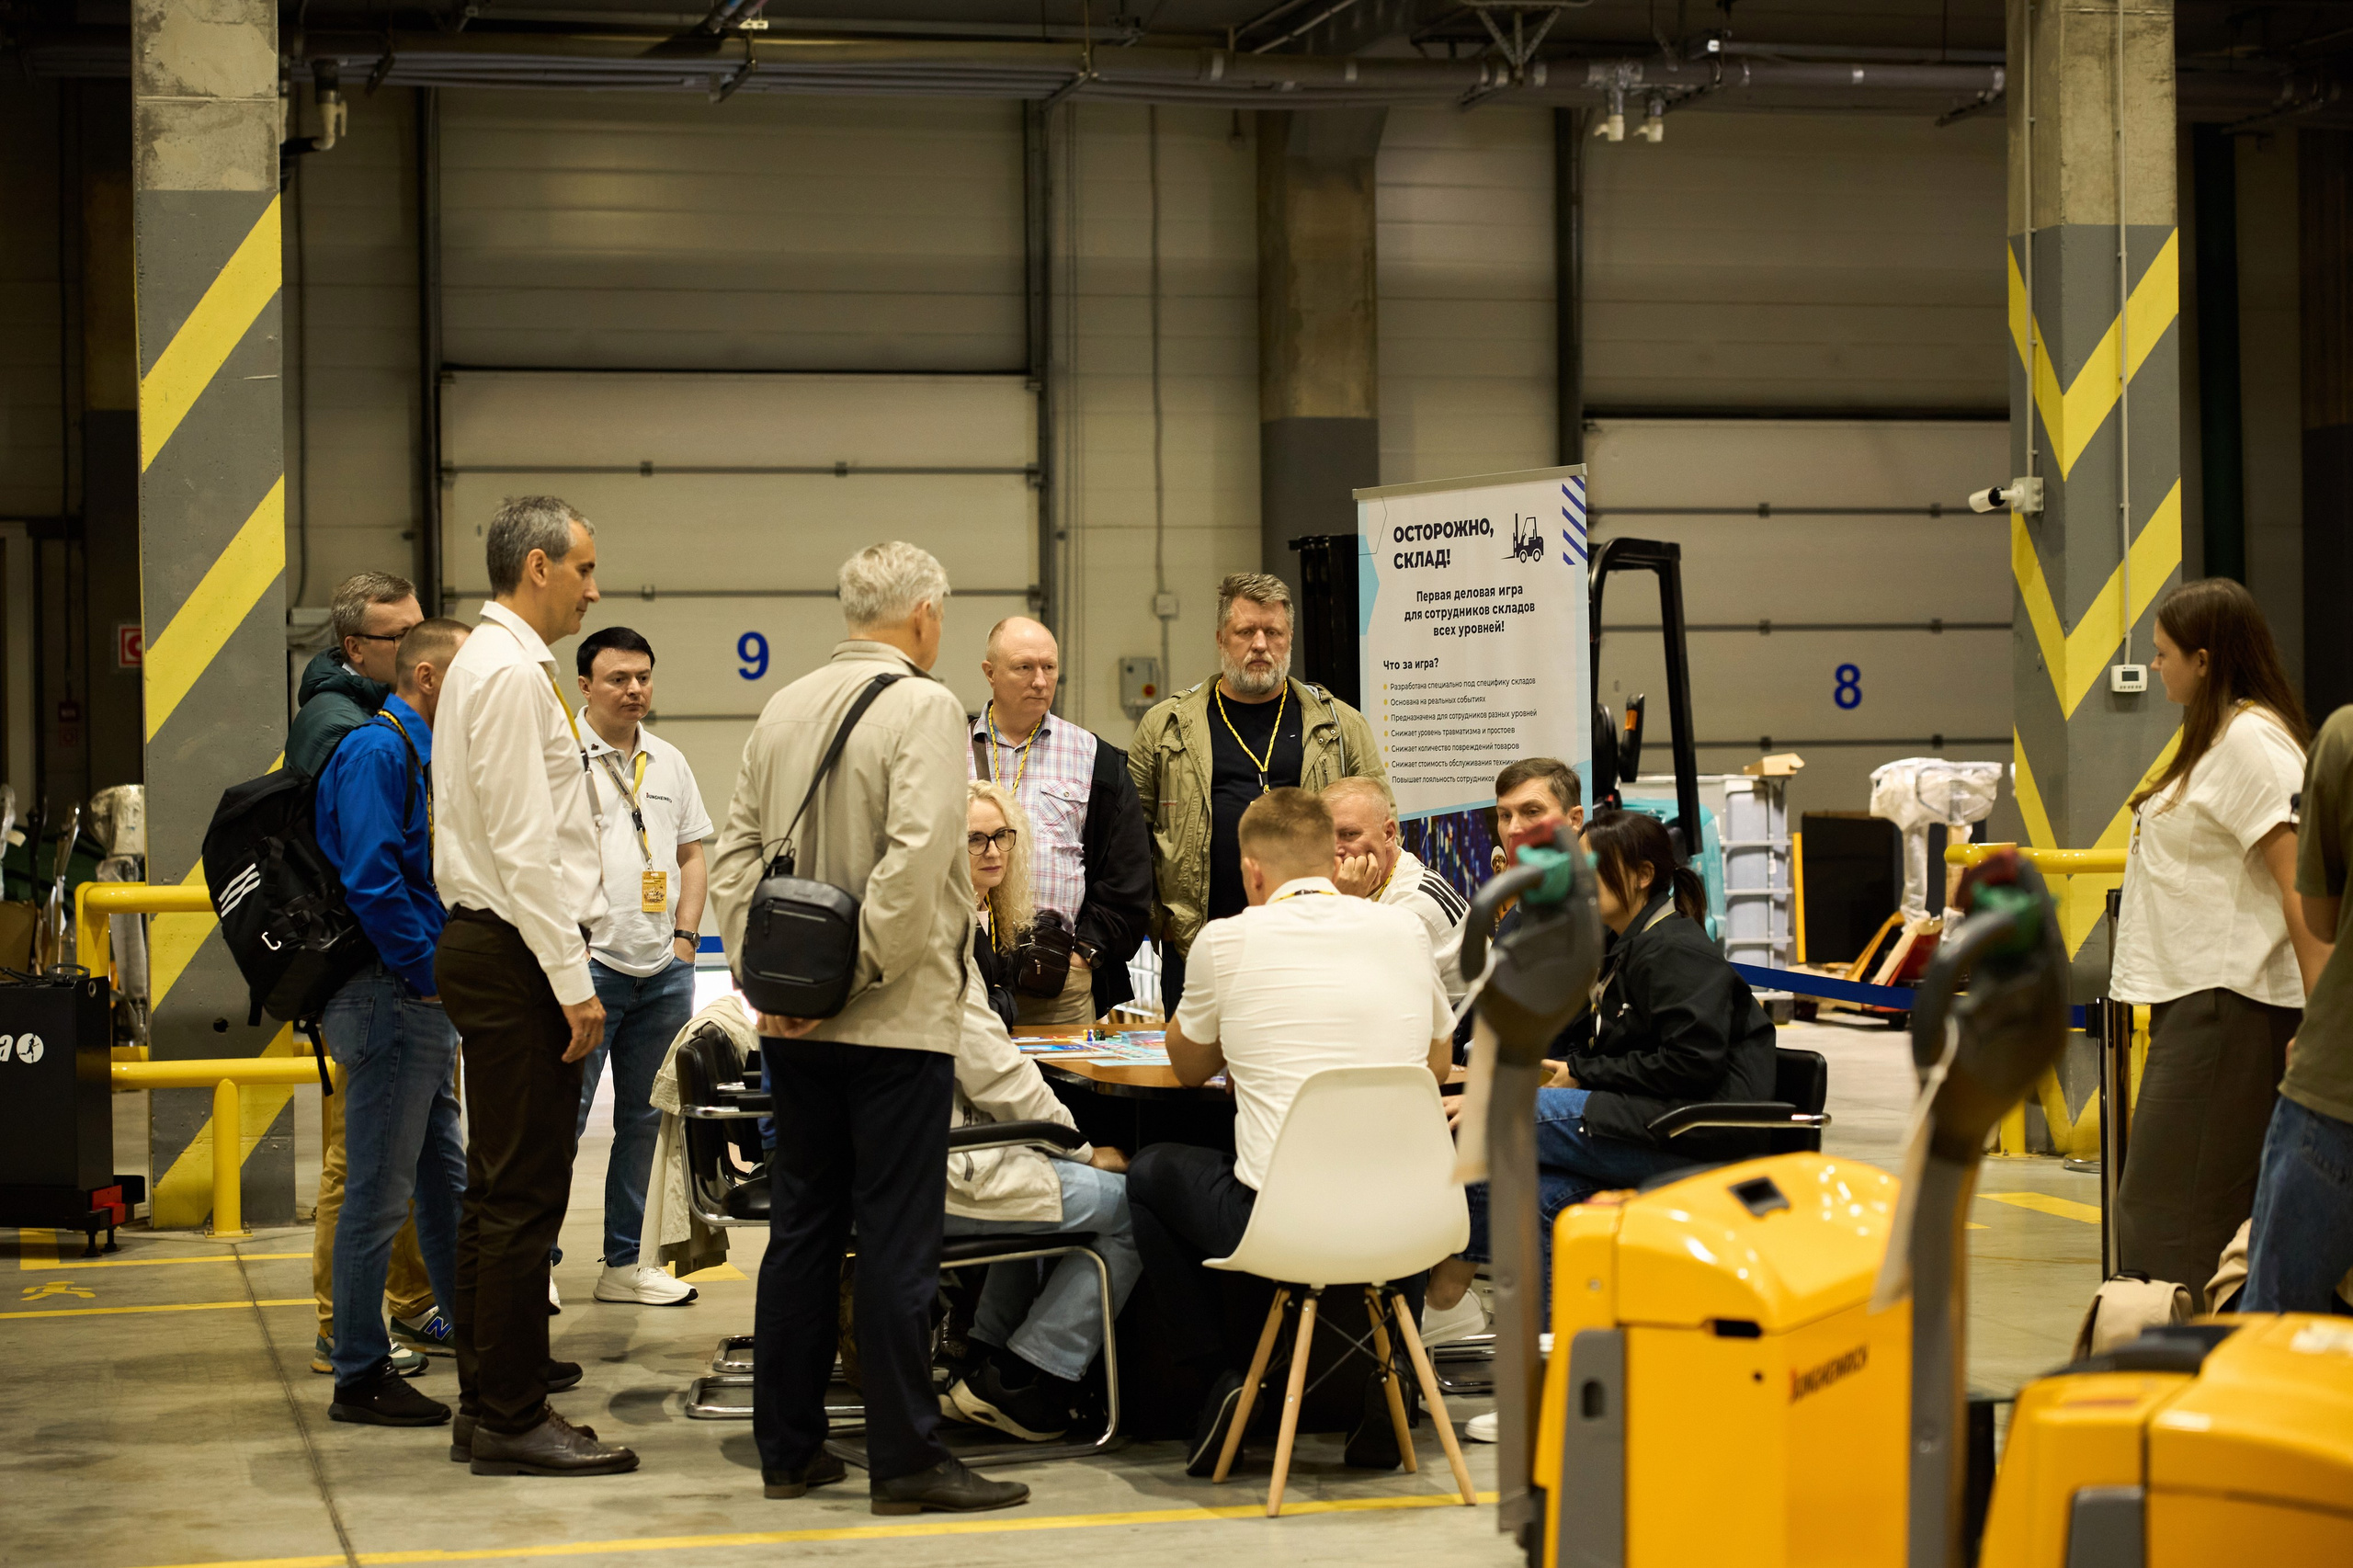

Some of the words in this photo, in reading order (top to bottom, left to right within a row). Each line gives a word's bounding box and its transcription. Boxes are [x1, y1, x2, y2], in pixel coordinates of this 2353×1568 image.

[1393, 518, 1494, 543] ОСТОРОЖНО,
[1393, 549, 1450, 569] СКЛАД!
[1416, 591, 1451, 604] Первая
[1454, 587, 1495, 601] деловая
[1499, 585, 1523, 597] игра
[1404, 611, 1422, 621] для
[1425, 607, 1490, 620] сотрудников
[1493, 603, 1535, 614] складов
[1434, 626, 1456, 636] всех
[1458, 620, 1505, 638] уровней!
[737, 631, 769, 681] 9
[1383, 660, 1401, 670] Что
[1415, 657, 1439, 671] игра?
[1391, 682, 1427, 691] Разработана
[1477, 678, 1509, 687] специфику
[1511, 677, 1536, 686] складов
[1834, 663, 1862, 710] 8
[1428, 698, 1456, 706] реальных
[1457, 695, 1485, 703] событиях
[1391, 714, 1436, 722] Предназначена
[1449, 712, 1487, 721] сотрудников
[1488, 711, 1509, 720] разных
[1511, 709, 1537, 719] уровней
[1418, 730, 1441, 738] уровень
[1452, 743, 1493, 752] повреждений
[1449, 759, 1492, 768] обслуживания
[1457, 776, 1495, 784] сотрудников
